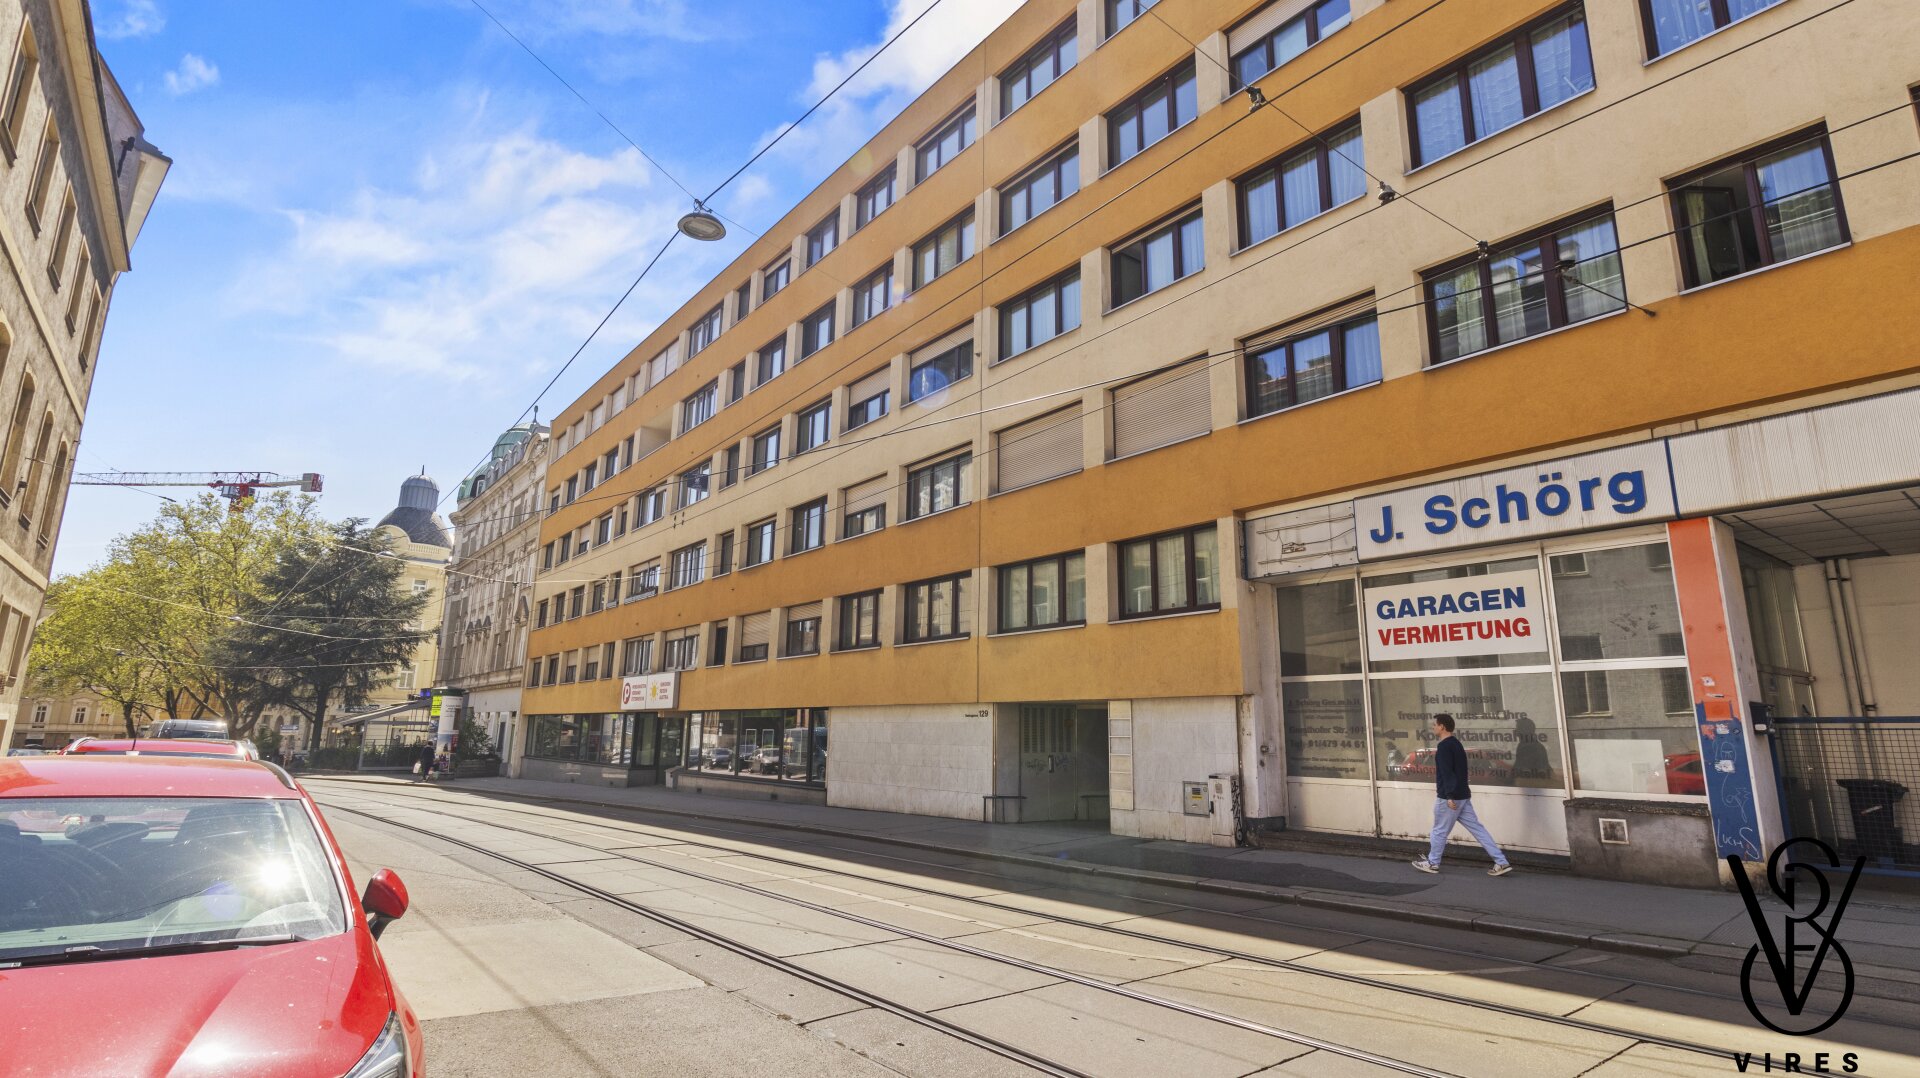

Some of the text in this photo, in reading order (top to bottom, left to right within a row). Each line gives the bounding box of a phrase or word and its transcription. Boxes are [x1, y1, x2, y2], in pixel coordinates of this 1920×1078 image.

[1369, 471, 1647, 543] J. Schörg
[1376, 586, 1526, 619] GARAGEN
[1378, 617, 1531, 646] VERMIETUNG
[1422, 694, 1497, 705] Bei Interesse
[979, 710, 989, 718] 129
[1416, 729, 1547, 743] Koktaufnahme
